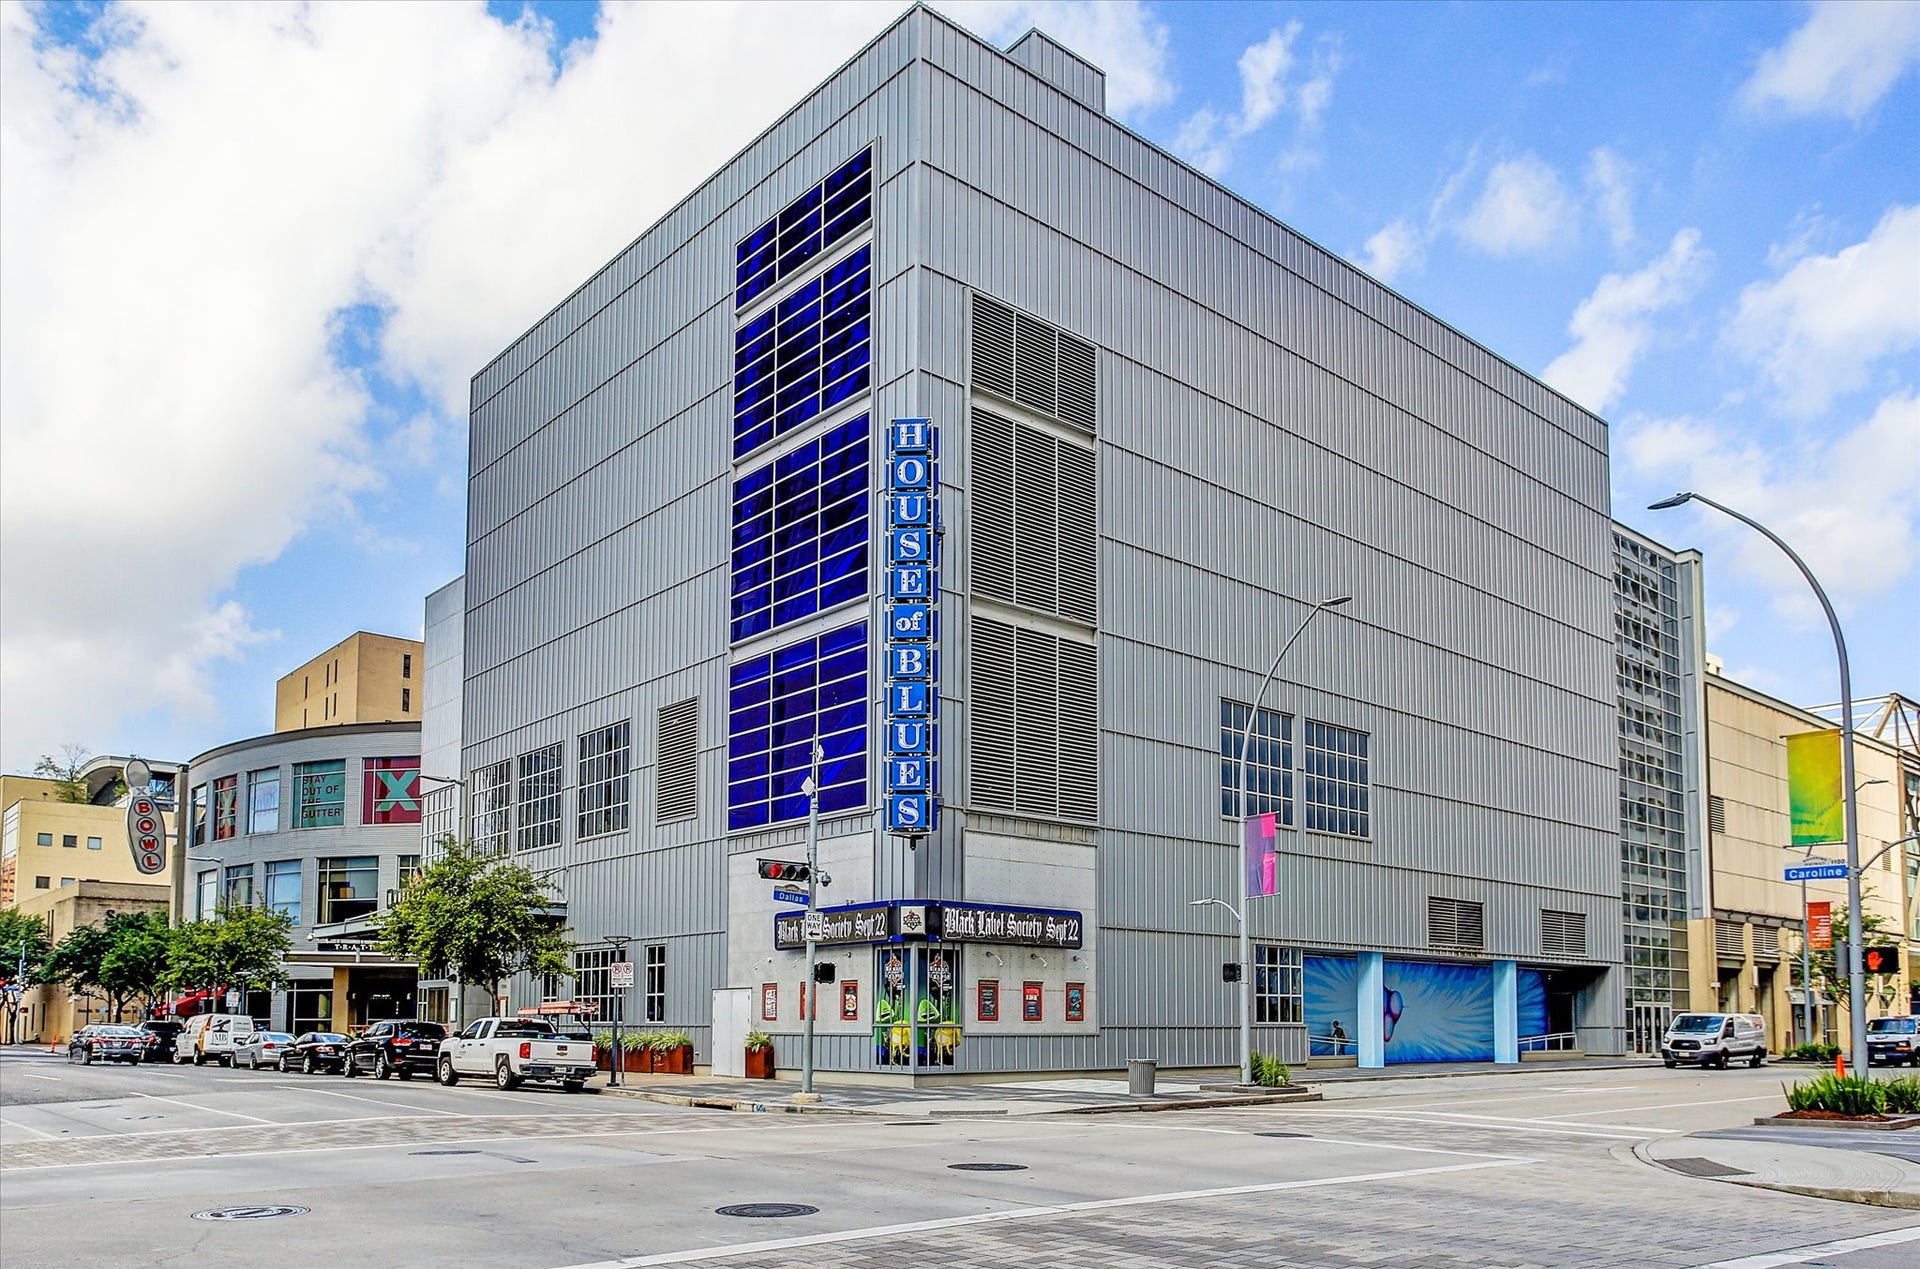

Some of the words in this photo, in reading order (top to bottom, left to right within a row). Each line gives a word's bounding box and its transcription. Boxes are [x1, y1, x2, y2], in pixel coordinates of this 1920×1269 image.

[896, 422, 926, 594] HOUSE
[896, 611, 924, 632] of
[894, 648, 923, 825] BLUES
[303, 775, 327, 785] STAY
[303, 787, 322, 796] OUT
[326, 785, 339, 794] OF
[136, 802, 158, 867] BOWL
[1789, 868, 1842, 879] Caroline
[779, 893, 803, 903] Dallas
[777, 919, 799, 943] Black
[823, 915, 852, 940] Society
[855, 911, 874, 941] Sept
[875, 911, 886, 937] 22
[807, 914, 821, 922] ONE
[945, 908, 975, 938] Black
[977, 910, 1004, 938] Label
[1007, 912, 1043, 940] Society
[1046, 916, 1067, 946] Sept
[1068, 918, 1079, 941] 22
